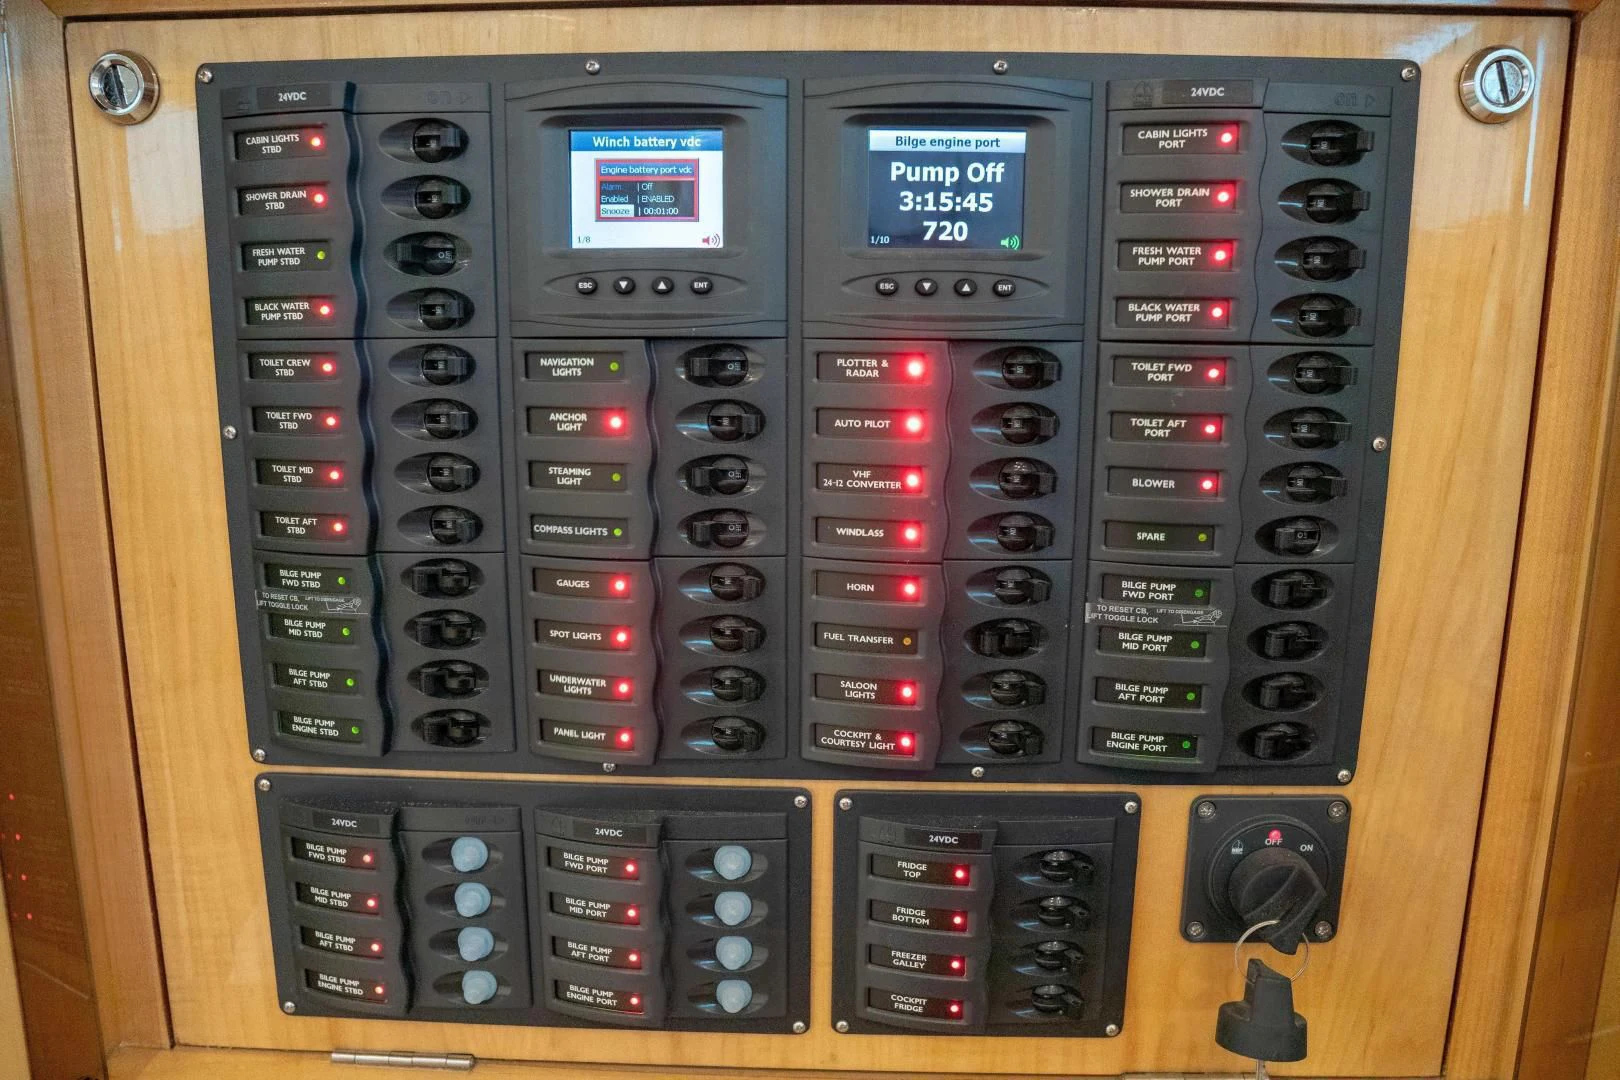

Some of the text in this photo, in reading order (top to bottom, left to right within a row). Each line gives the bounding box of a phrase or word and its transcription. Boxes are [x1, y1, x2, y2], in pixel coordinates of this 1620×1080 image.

[278, 92, 307, 101] 24VDC
[1190, 88, 1224, 97] 24VDC
[1138, 129, 1208, 139] CABIN LIGHTS
[246, 134, 299, 145] CABIN LIGHTS
[593, 136, 701, 149] Winch battery vdc
[895, 137, 1000, 149] Bilge engine port
[1158, 140, 1186, 148] PORT
[601, 166, 627, 175] Engine
[629, 166, 658, 175] battery
[660, 167, 677, 175] port
[891, 162, 1005, 186] Pump Off
[1130, 188, 1210, 197] SHOWER DRAIN
[899, 192, 993, 212] 3:15:45
[1155, 199, 1182, 207] PORT
[923, 221, 968, 241] 720
[871, 236, 890, 244] 1/10
[1132, 247, 1201, 256] FRESH WATER
[1138, 257, 1195, 266] PUMP PORT
[255, 302, 309, 311] BLACK WATER
[1128, 304, 1200, 312] BLACK WATER
[283, 312, 303, 320] STBD
[1136, 314, 1192, 322] PUMP PORT
[259, 359, 310, 367] TOILET CREW
[540, 358, 594, 366] NAVIGATION
[837, 359, 877, 368] PLOTTER
[552, 368, 581, 376] LIGHTS
[1131, 363, 1192, 372] TOILET FWD
[846, 369, 879, 377] RADAR
[1148, 374, 1173, 382] PORT
[549, 413, 587, 421] ANCHOR
[557, 423, 582, 431] LIGHT
[835, 420, 891, 428] AUTO PILOT
[1130, 419, 1187, 428] TOILET AFT
[1144, 429, 1170, 437] PORT
[549, 468, 591, 476] STEAMING
[853, 470, 871, 478] VHF
[557, 477, 582, 485] LIGHT
[846, 480, 901, 489] CONVERTER
[1132, 479, 1175, 489] BLOWER
[276, 517, 317, 526] TOILET AFT
[534, 525, 608, 535] COMPASS LIGHTS
[836, 528, 884, 537] WINDLASS
[1137, 532, 1166, 541] SPARE
[280, 569, 321, 579] BILGE PUMP
[282, 579, 320, 588] FWD STBD
[556, 579, 590, 588] GAUGES
[847, 583, 874, 591] HORN
[1121, 581, 1176, 591] BILGE PUMP
[1122, 590, 1174, 600] FWD PORT
[1108, 605, 1133, 613] RESET
[1105, 613, 1137, 622] TOGGLE
[1138, 615, 1158, 624] LOCK
[550, 630, 601, 641] SPOT LIGHTS
[824, 633, 893, 644] FUEL TRANSFER
[550, 675, 606, 687] UNDERWATER
[840, 681, 877, 690] SALOON
[564, 685, 592, 695] LIGHTS
[845, 690, 875, 699] LIGHTS
[293, 716, 335, 727] BILGE PUMP
[292, 725, 338, 736] ENGINE STBD
[554, 728, 606, 740] PANEL LIGHT
[834, 730, 873, 739] COCKPIT
[1111, 732, 1164, 743] BILGE PUMP
[821, 737, 895, 750] COURTESY LIGHT
[1107, 741, 1167, 752] ENGINE PORT
[332, 818, 357, 827] 24VDC
[595, 828, 623, 837] 24VDC
[929, 835, 958, 844] 24VDC
[1265, 838, 1283, 846] OFF
[306, 843, 347, 855] BILGE PUMP
[308, 851, 346, 864] FWD STBD
[563, 852, 608, 865] BILGE PUMP
[565, 861, 608, 873] FWD PORT
[897, 861, 927, 870] FRIDGE
[904, 870, 921, 878] TOP
[891, 951, 927, 961] FREEZER
[893, 959, 925, 969] GALLEY
[569, 985, 613, 998] BILGE PUMP
[567, 992, 617, 1006] ENGINE PORT
[891, 995, 927, 1005] COCKPIT
[894, 1003, 923, 1012] FRIDGE
